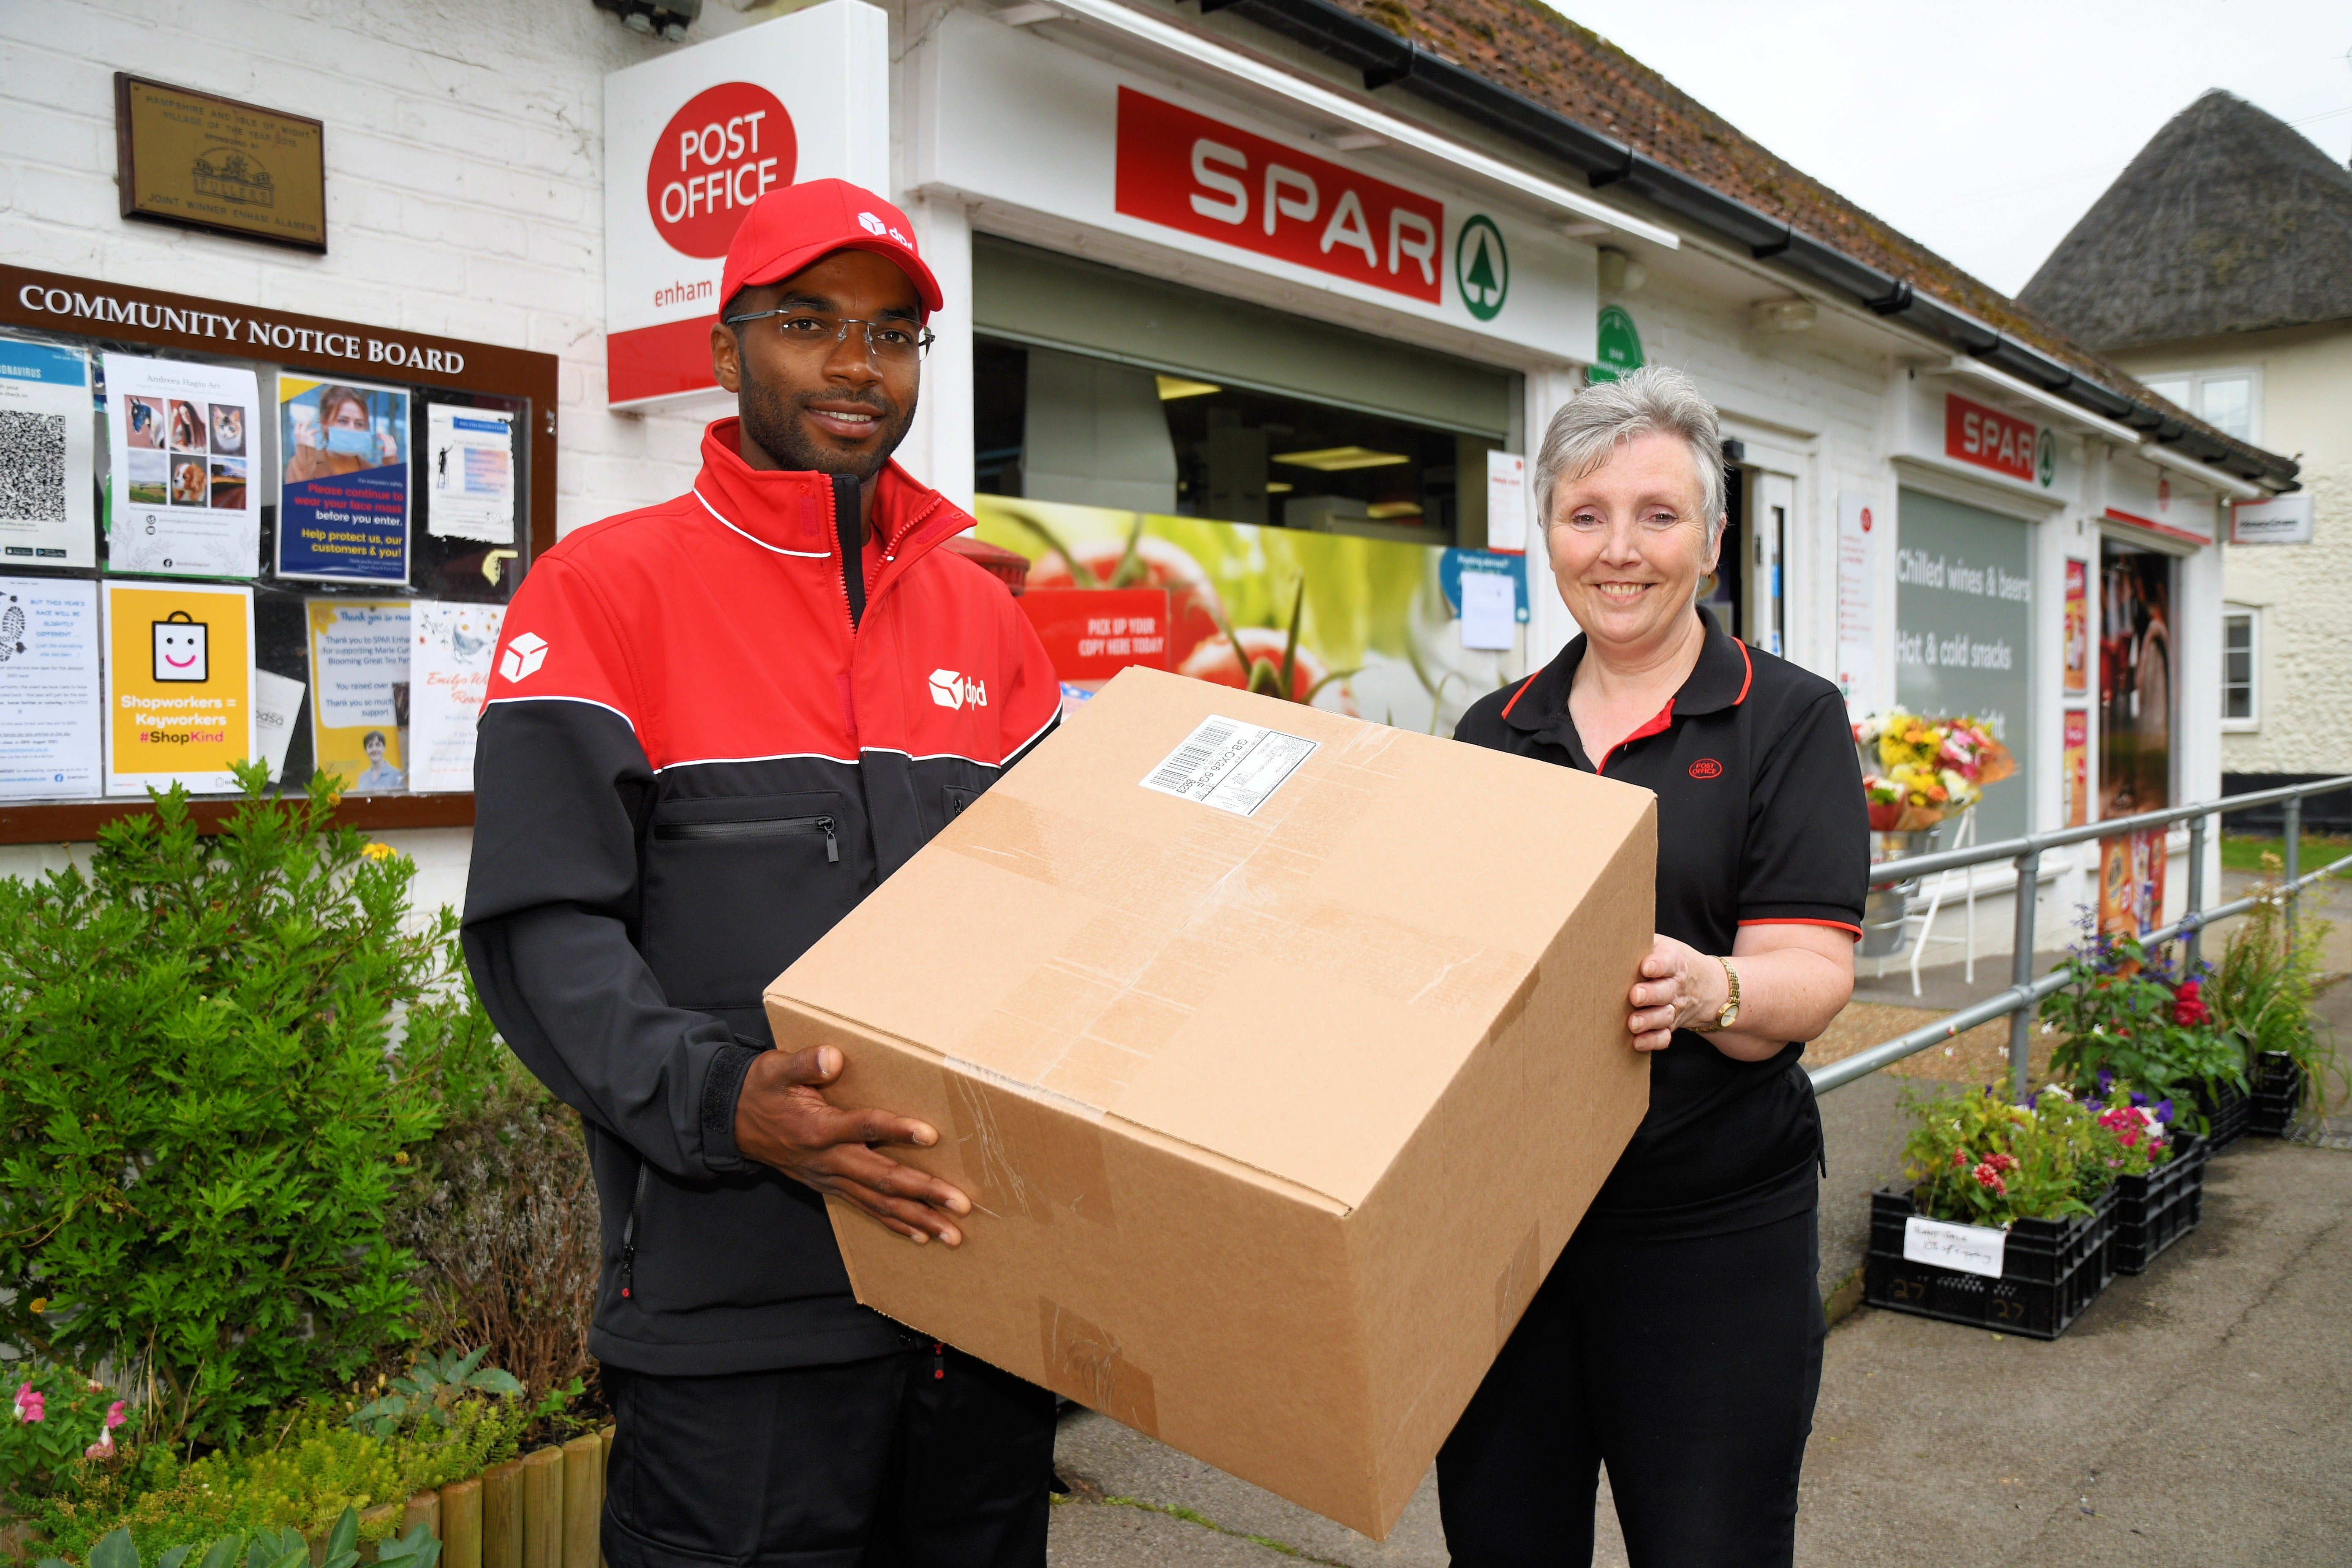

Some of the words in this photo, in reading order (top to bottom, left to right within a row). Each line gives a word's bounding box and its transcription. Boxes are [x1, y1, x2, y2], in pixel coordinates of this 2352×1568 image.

[147, 95, 205, 114] HAMPSHIRE
[212, 111, 231, 121] AND
[237, 116, 257, 127] ISLE
[282, 127, 310, 139] WIGHT
[164, 112, 202, 126] VILLAGE
[227, 126, 243, 136] THE
[250, 132, 272, 141] YEAR
[205, 133, 247, 147] SPONSORED
[681, 110, 766, 172] POST
[660, 157, 778, 223] OFFICE
[149, 194, 180, 206] JOINT
[187, 200, 227, 215] WINNER
[234, 210, 269, 223] ENHAM
[275, 217, 317, 232] ALAMEIN
[1189, 138, 1436, 286] SPAR
[889, 227, 913, 250] dpd
[655, 280, 713, 307] enham
[19, 284, 241, 340] COMMUNITY
[248, 320, 361, 359] NOTICE
[367, 338, 465, 374] BOARD
[1963, 411, 2033, 471] SPAR
[308, 484, 343, 495] Please
[346, 488, 391, 500] continue
[393, 492, 404, 501] to
[294, 497, 321, 506] wear
[324, 499, 348, 509] your
[350, 500, 373, 511] face
[375, 504, 403, 514] mask
[315, 509, 350, 522] before
[352, 513, 372, 525] you
[374, 517, 403, 526] enter.
[302, 529, 327, 541] Help
[329, 531, 367, 542] protect
[369, 534, 383, 544] us,
[386, 536, 403, 545] our
[311, 543, 367, 555] customers
[369, 546, 377, 555] &
[379, 548, 402, 558] you!
[1897, 548, 1945, 588] Chilled
[1947, 557, 1984, 595] wines
[1986, 565, 1997, 597] &
[1998, 565, 2030, 602] beers
[341, 611, 366, 622] Thank
[368, 615, 382, 625] you
[1088, 618, 1111, 636] PICK
[1112, 618, 1128, 635] UP
[1129, 617, 1156, 634] YOUR
[335, 647, 374, 656] supporting
[375, 646, 395, 654] Marie
[1078, 638, 1105, 656] COPY
[1106, 637, 1131, 655] HERE
[1132, 637, 1165, 653] TODAY
[1897, 629, 1922, 665] Hot
[1925, 631, 1938, 667] &
[1939, 632, 1970, 667] cold
[1970, 637, 2012, 671] snacks
[329, 658, 362, 666] Blooming
[427, 672, 467, 690] Emilys
[965, 676, 987, 710] dpd
[121, 695, 223, 711] Shopworkers
[227, 699, 237, 707] =
[135, 713, 227, 729] Keyworkers
[362, 709, 389, 717] support
[140, 730, 224, 745] #ShopKind
[1211, 739, 1248, 771] GB-OX26
[1176, 779, 1196, 793] 0029
[1197, 772, 1214, 788] 6GF
[1894, 1278, 1926, 1298] 27
[1992, 1298, 2025, 1319] 27
